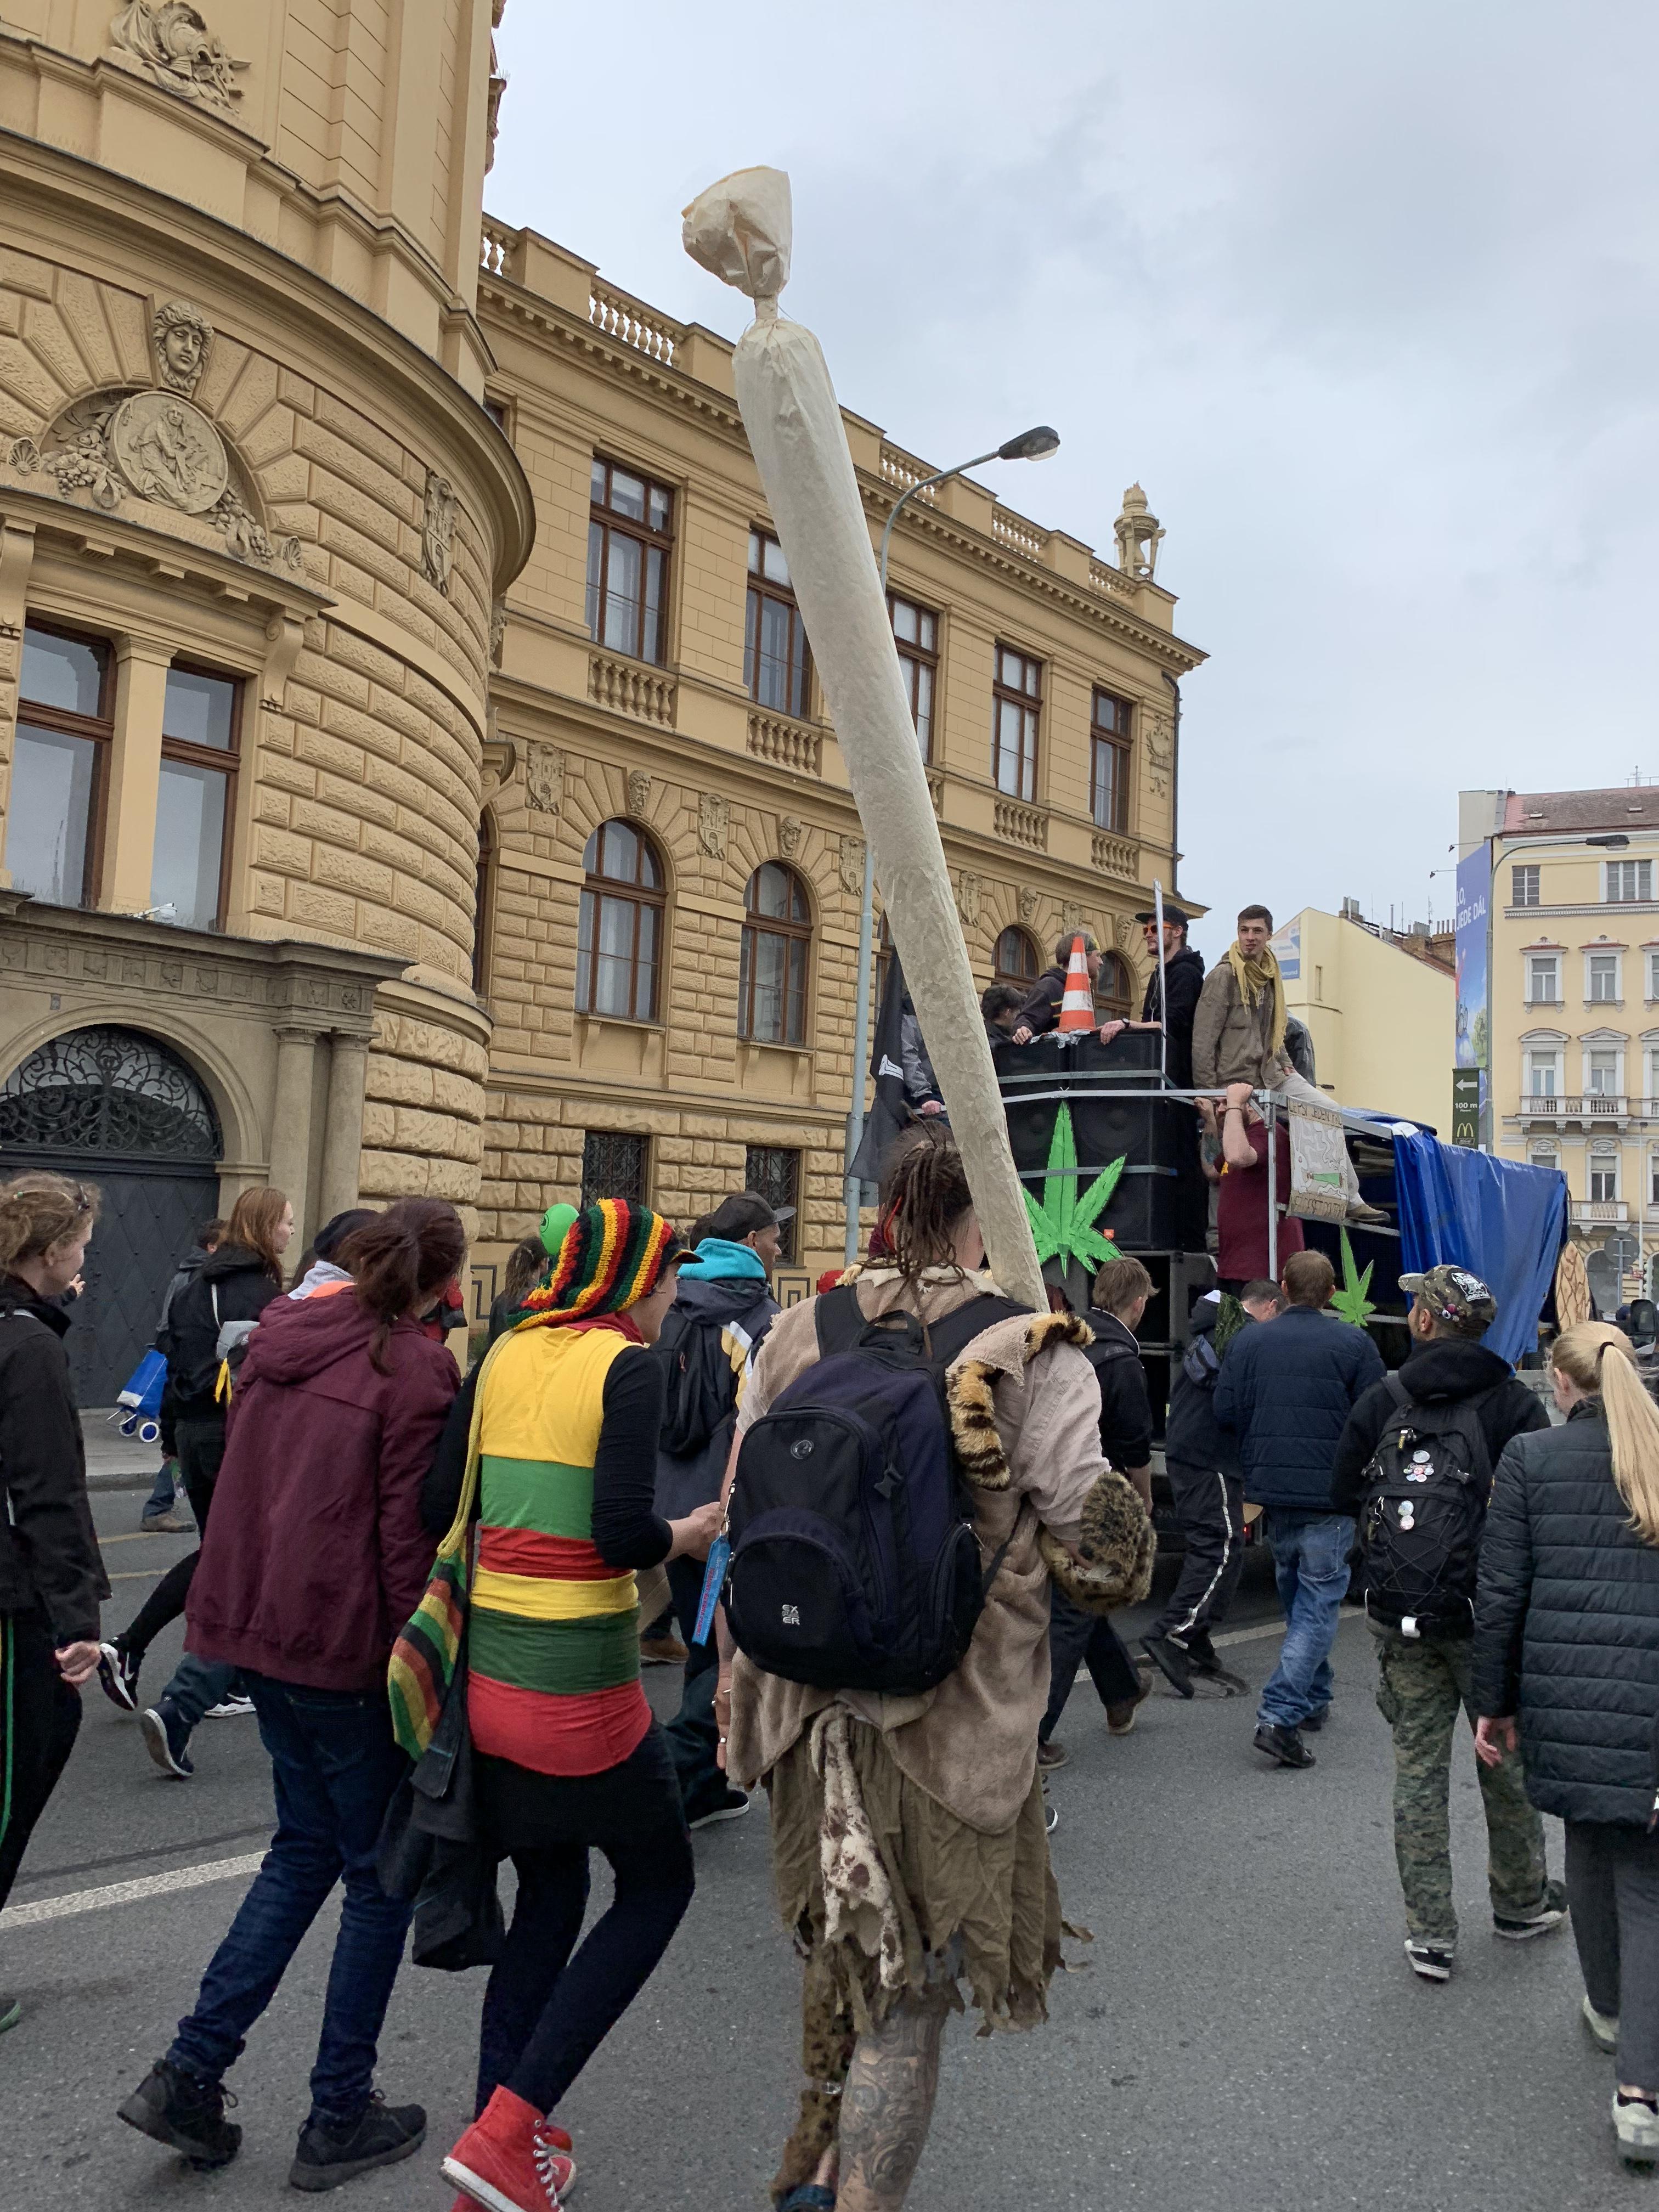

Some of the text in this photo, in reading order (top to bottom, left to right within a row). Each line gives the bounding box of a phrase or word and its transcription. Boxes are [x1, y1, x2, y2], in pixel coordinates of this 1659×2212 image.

[1457, 895, 1486, 930] JEDE DÁL
[782, 1604, 799, 1613] EX
[783, 1616, 800, 1625] ER
